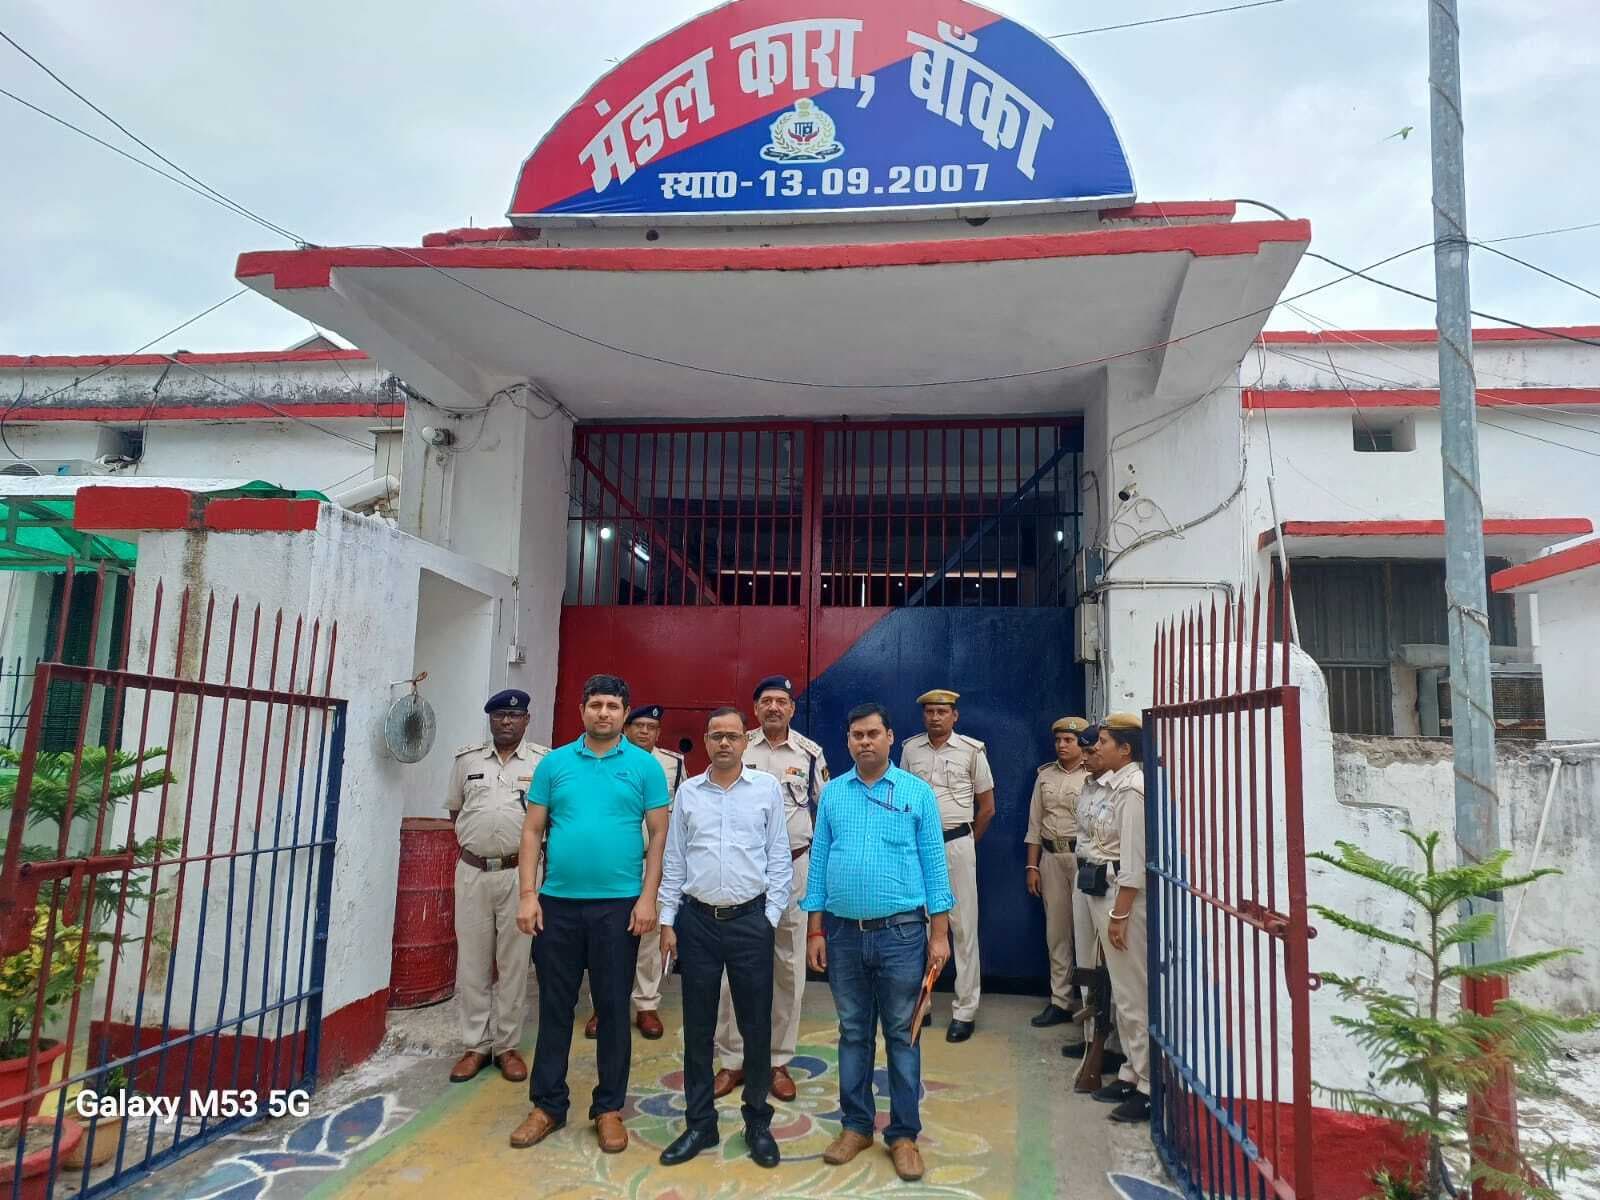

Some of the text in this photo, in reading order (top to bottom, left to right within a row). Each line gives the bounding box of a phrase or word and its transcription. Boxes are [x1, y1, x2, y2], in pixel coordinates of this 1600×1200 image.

[578, 18, 1055, 193] मंडल कारा, बाँका
